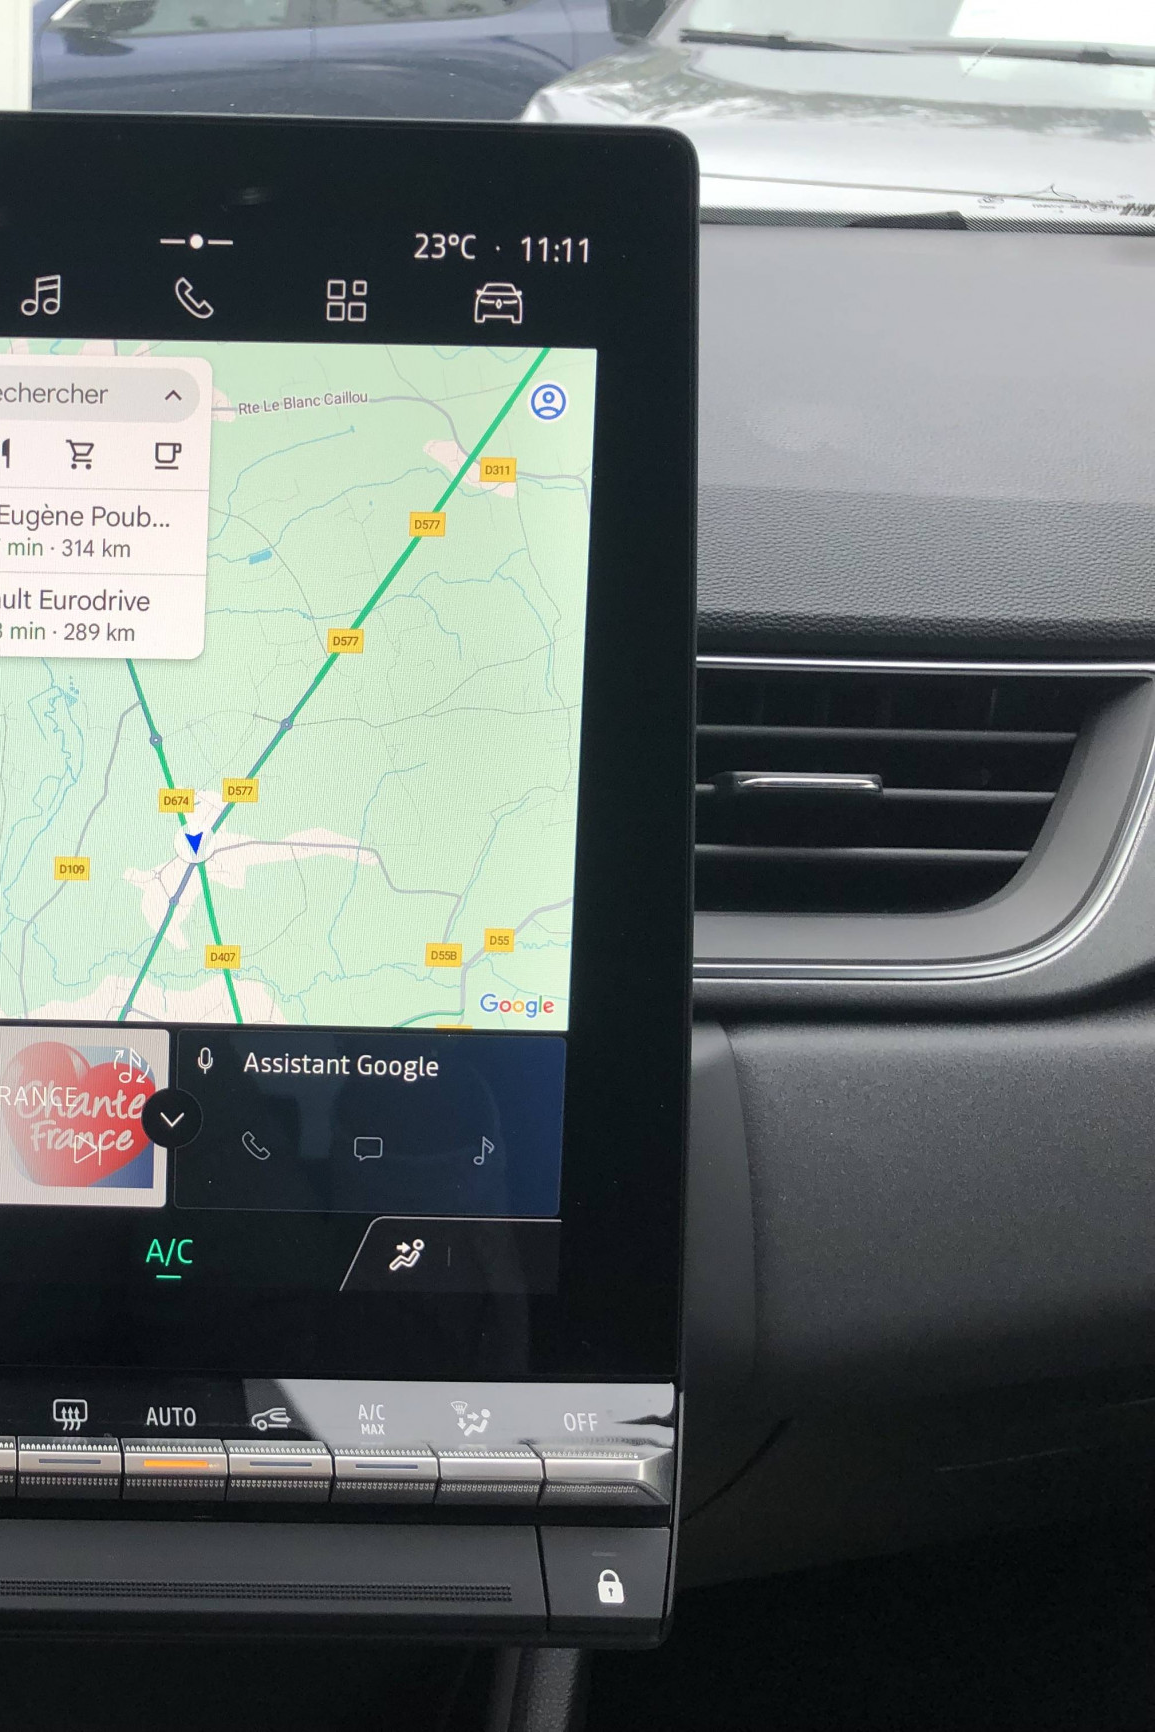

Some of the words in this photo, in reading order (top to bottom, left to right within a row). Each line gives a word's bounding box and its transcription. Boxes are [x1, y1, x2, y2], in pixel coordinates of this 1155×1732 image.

[413, 233, 477, 260] 23°C
[521, 236, 590, 263] 11:11
[238, 401, 259, 415] Rte
[262, 399, 280, 413] Le
[283, 395, 322, 412] Blanc
[324, 391, 369, 408] Caillou
[485, 464, 511, 476] D311
[414, 518, 441, 531] D577
[7, 539, 44, 557] min
[61, 540, 95, 558] 314
[102, 540, 132, 558] km
[40, 589, 151, 613] Eurodrive
[10, 623, 47, 641] min
[64, 624, 101, 642] 289
[107, 624, 136, 643] km
[332, 635, 360, 647] D577
[227, 785, 254, 797] D577
[163, 795, 190, 807] D674
[59, 864, 86, 875] D109
[489, 935, 511, 946] D55
[210, 952, 236, 963] D407
[431, 950, 458, 961] D55B
[480, 993, 556, 1018] Google
[243, 1052, 351, 1076] Assistant
[357, 1054, 440, 1082] Google
[15, 1079, 147, 1120] Chante
[29, 1119, 135, 1152] France
[146, 1239, 194, 1267] A/C
[146, 1406, 197, 1427] AUTO
[358, 1404, 386, 1422] A/C
[563, 1412, 599, 1432] OFF
[361, 1423, 386, 1436] MAX
